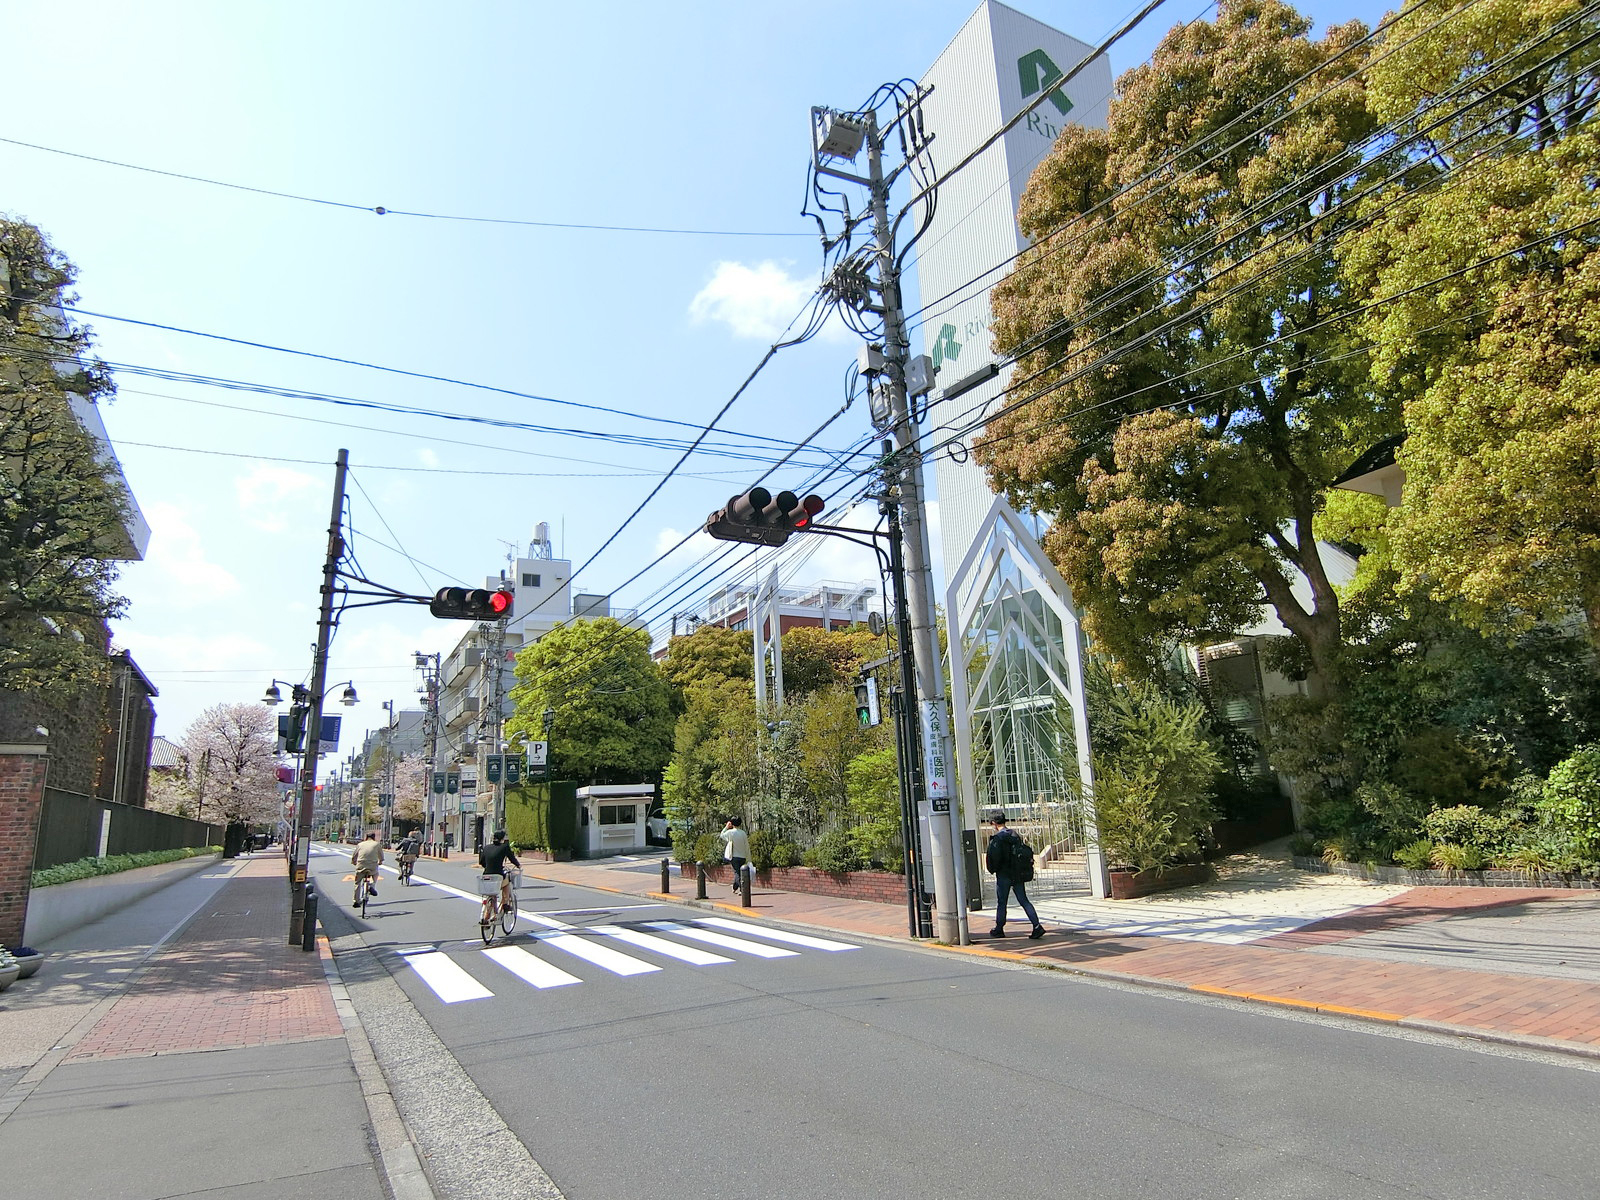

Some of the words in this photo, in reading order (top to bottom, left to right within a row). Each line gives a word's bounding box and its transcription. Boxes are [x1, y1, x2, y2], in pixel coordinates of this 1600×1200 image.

[928, 700, 940, 732] 大久保
[534, 743, 543, 755] P
[934, 756, 945, 778] 医院
